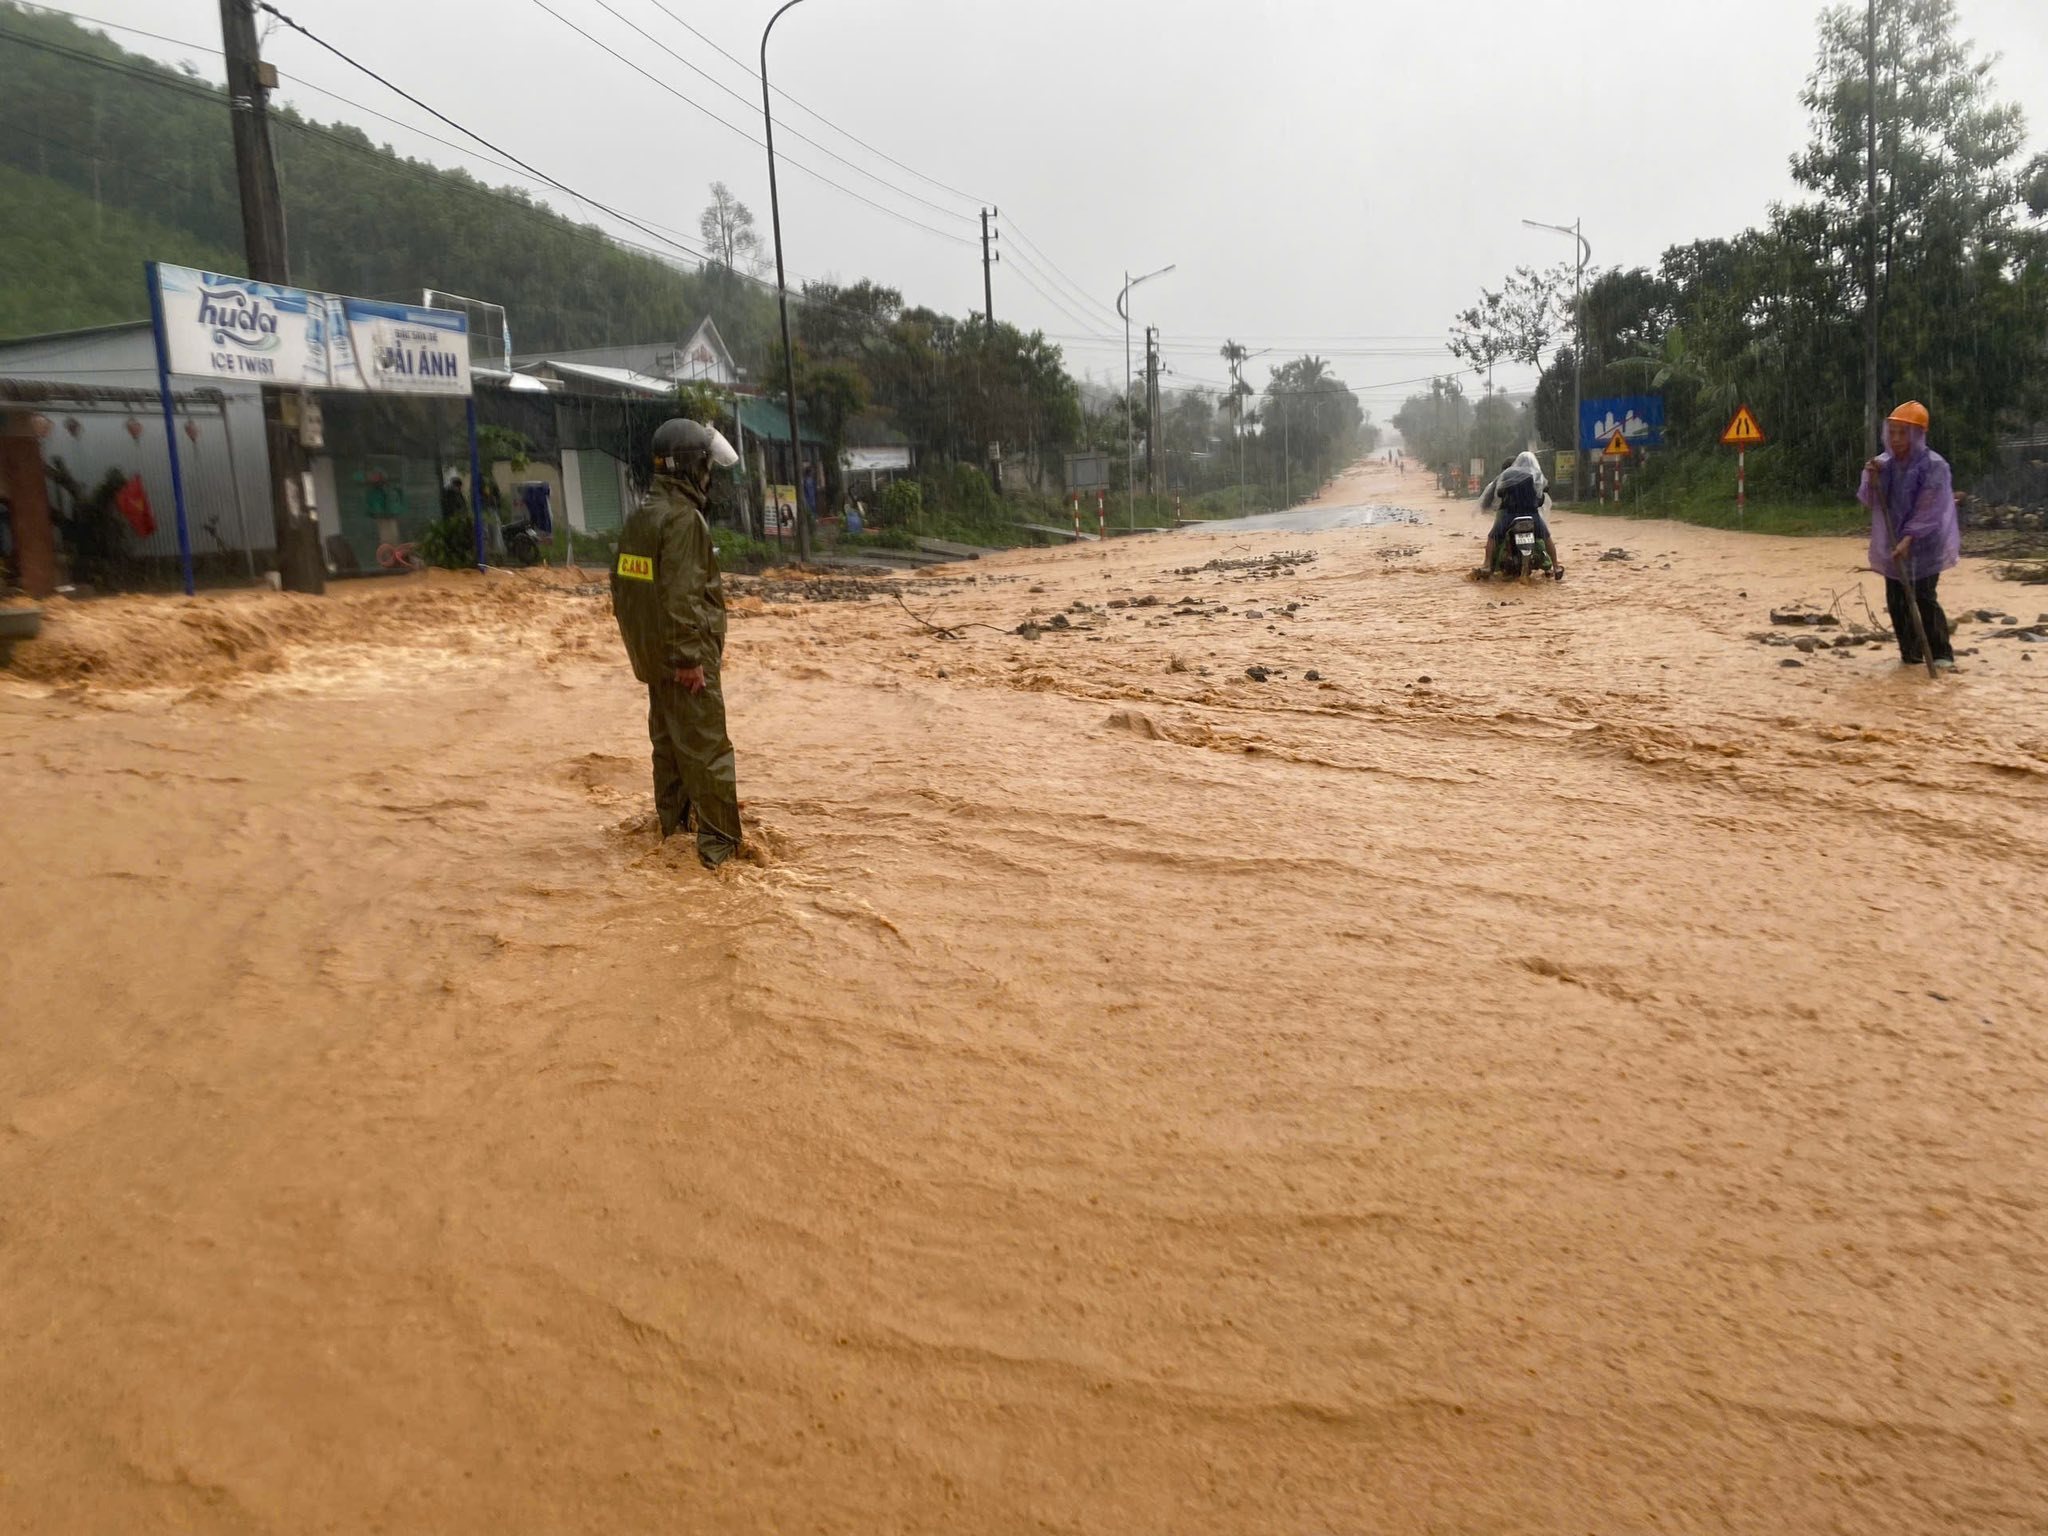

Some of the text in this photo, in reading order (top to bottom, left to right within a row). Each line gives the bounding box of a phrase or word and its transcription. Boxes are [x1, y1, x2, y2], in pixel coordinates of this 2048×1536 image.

[197, 287, 278, 333] huda
[211, 352, 275, 374] ICE TWIST
